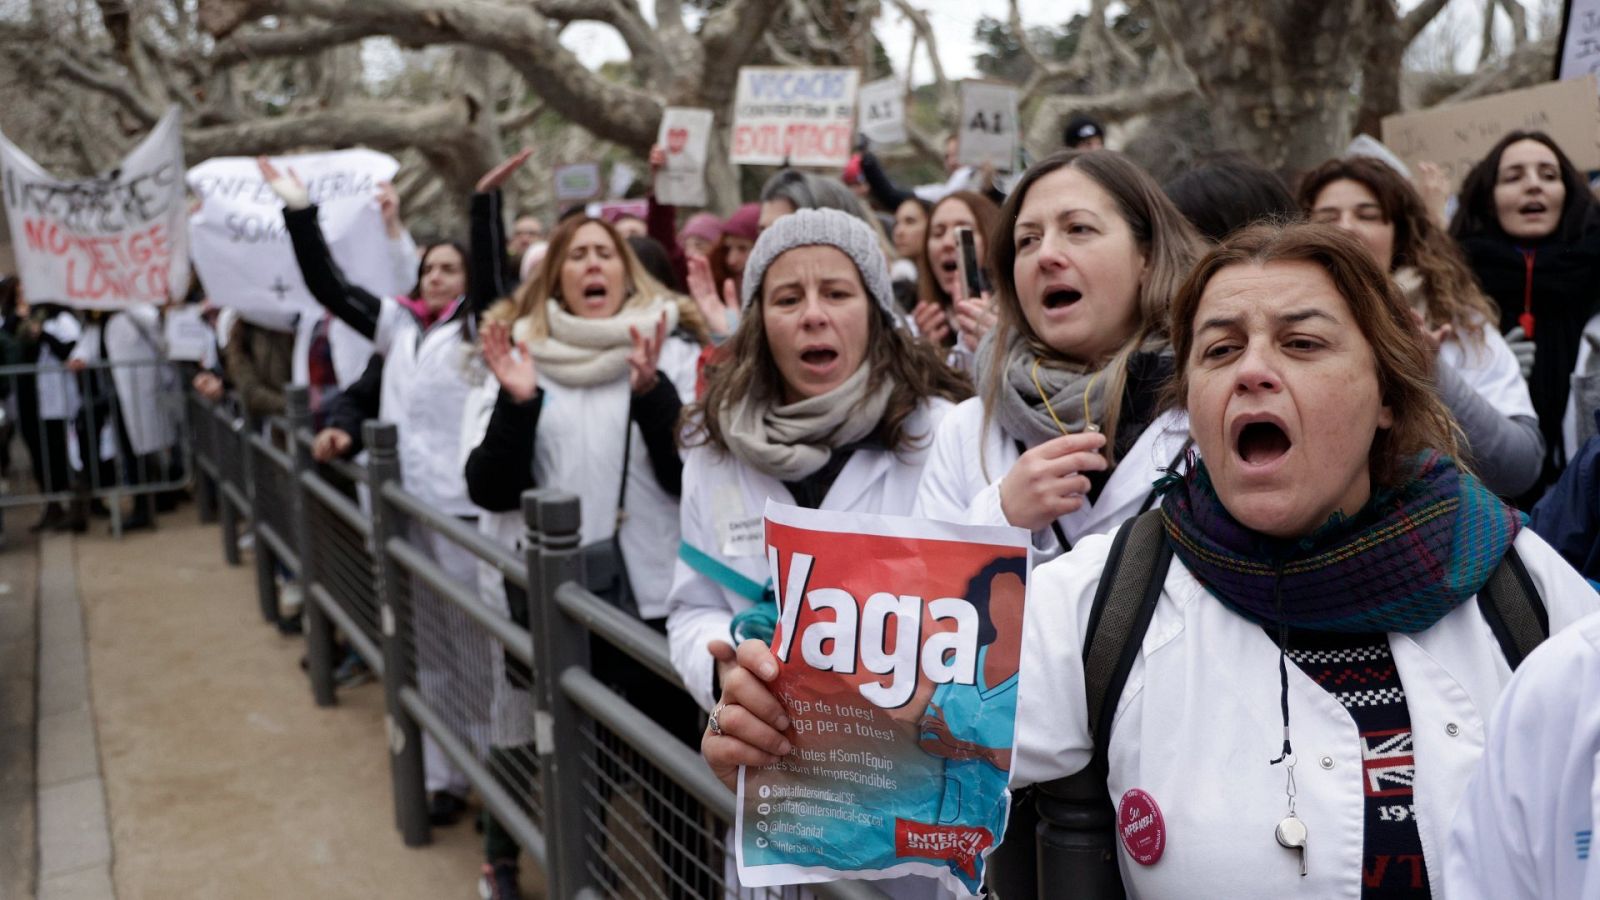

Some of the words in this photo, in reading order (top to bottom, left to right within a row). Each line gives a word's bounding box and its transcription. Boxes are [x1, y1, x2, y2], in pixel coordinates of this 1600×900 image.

[767, 544, 980, 709] Vaga
[815, 700, 831, 714] de
[836, 704, 874, 722] totes!
[817, 720, 838, 734] per
[844, 723, 852, 734] a
[856, 723, 895, 741] totes!
[801, 747, 826, 762] totes
[830, 748, 893, 772] #Som1Equip
[813, 766, 897, 790] #Imprescindibles
[770, 820, 824, 838] @InterSanitat
[907, 831, 958, 842] INTER
